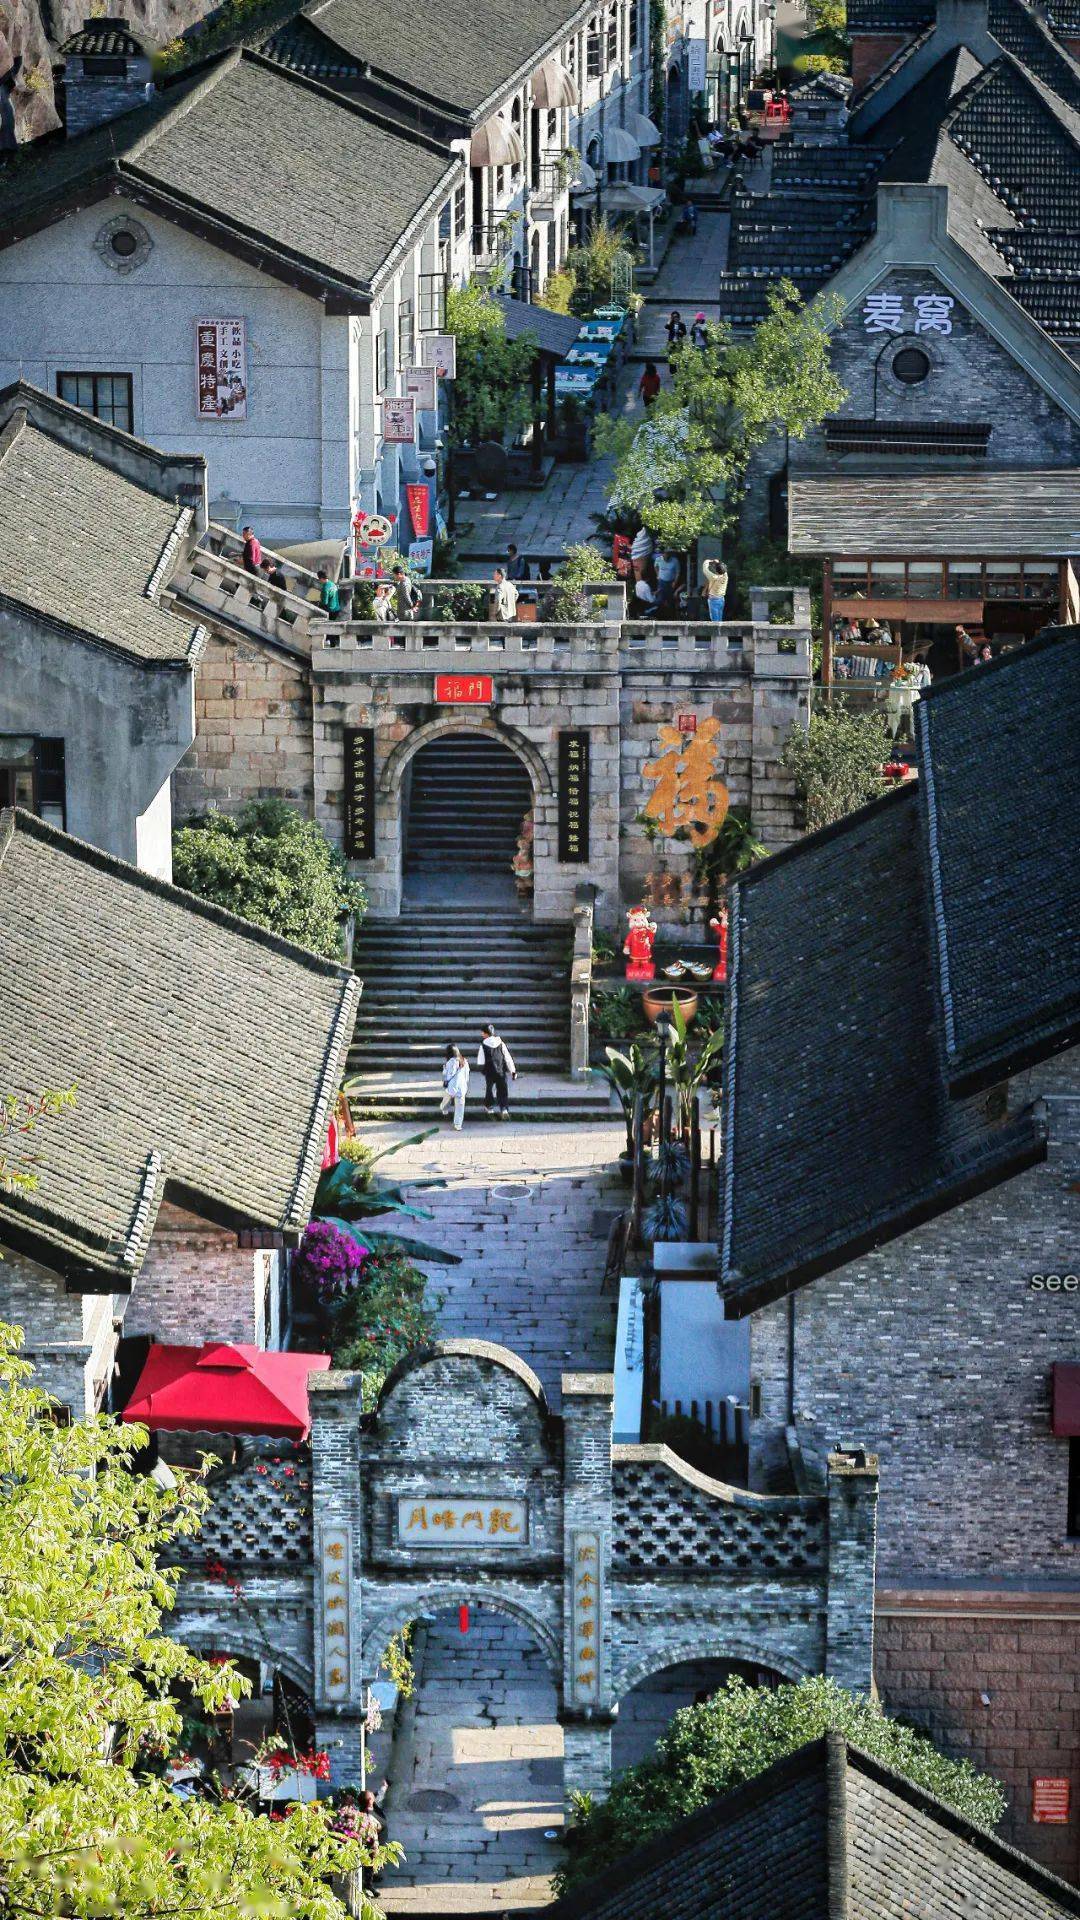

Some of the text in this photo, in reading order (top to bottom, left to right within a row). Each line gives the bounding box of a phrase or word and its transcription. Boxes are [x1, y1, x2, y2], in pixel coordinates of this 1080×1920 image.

[863, 292, 954, 335] 麦窝
[642, 715, 730, 848] 福
[1031, 1274, 1079, 1291] see
